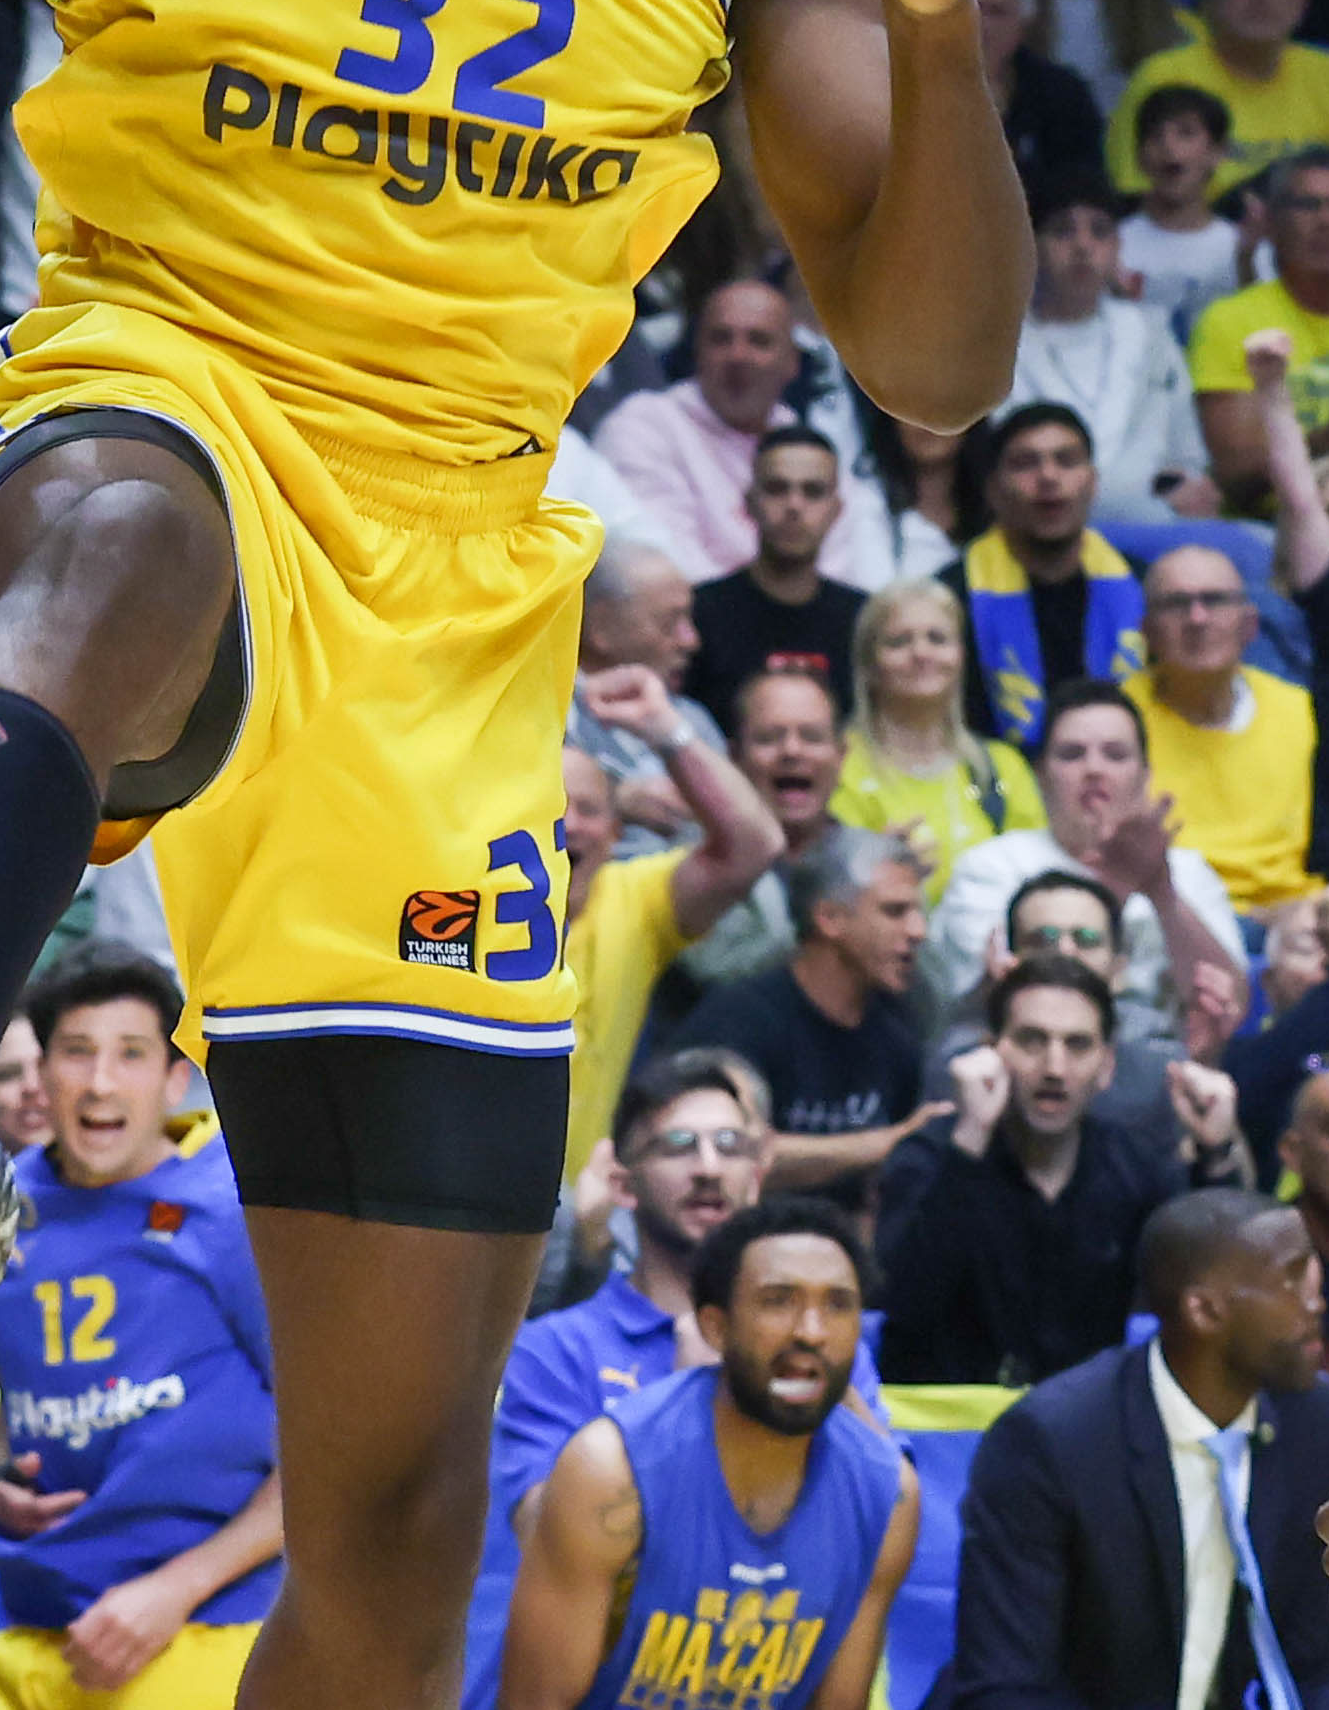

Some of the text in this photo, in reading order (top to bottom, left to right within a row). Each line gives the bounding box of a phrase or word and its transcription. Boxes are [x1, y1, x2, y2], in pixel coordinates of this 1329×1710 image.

[203, 63, 641, 206] Playtika
[485, 817, 567, 982] 3
[406, 940, 469, 956] TURKISH
[407, 954, 469, 968] AIRLINES
[34, 1275, 117, 1366] 12
